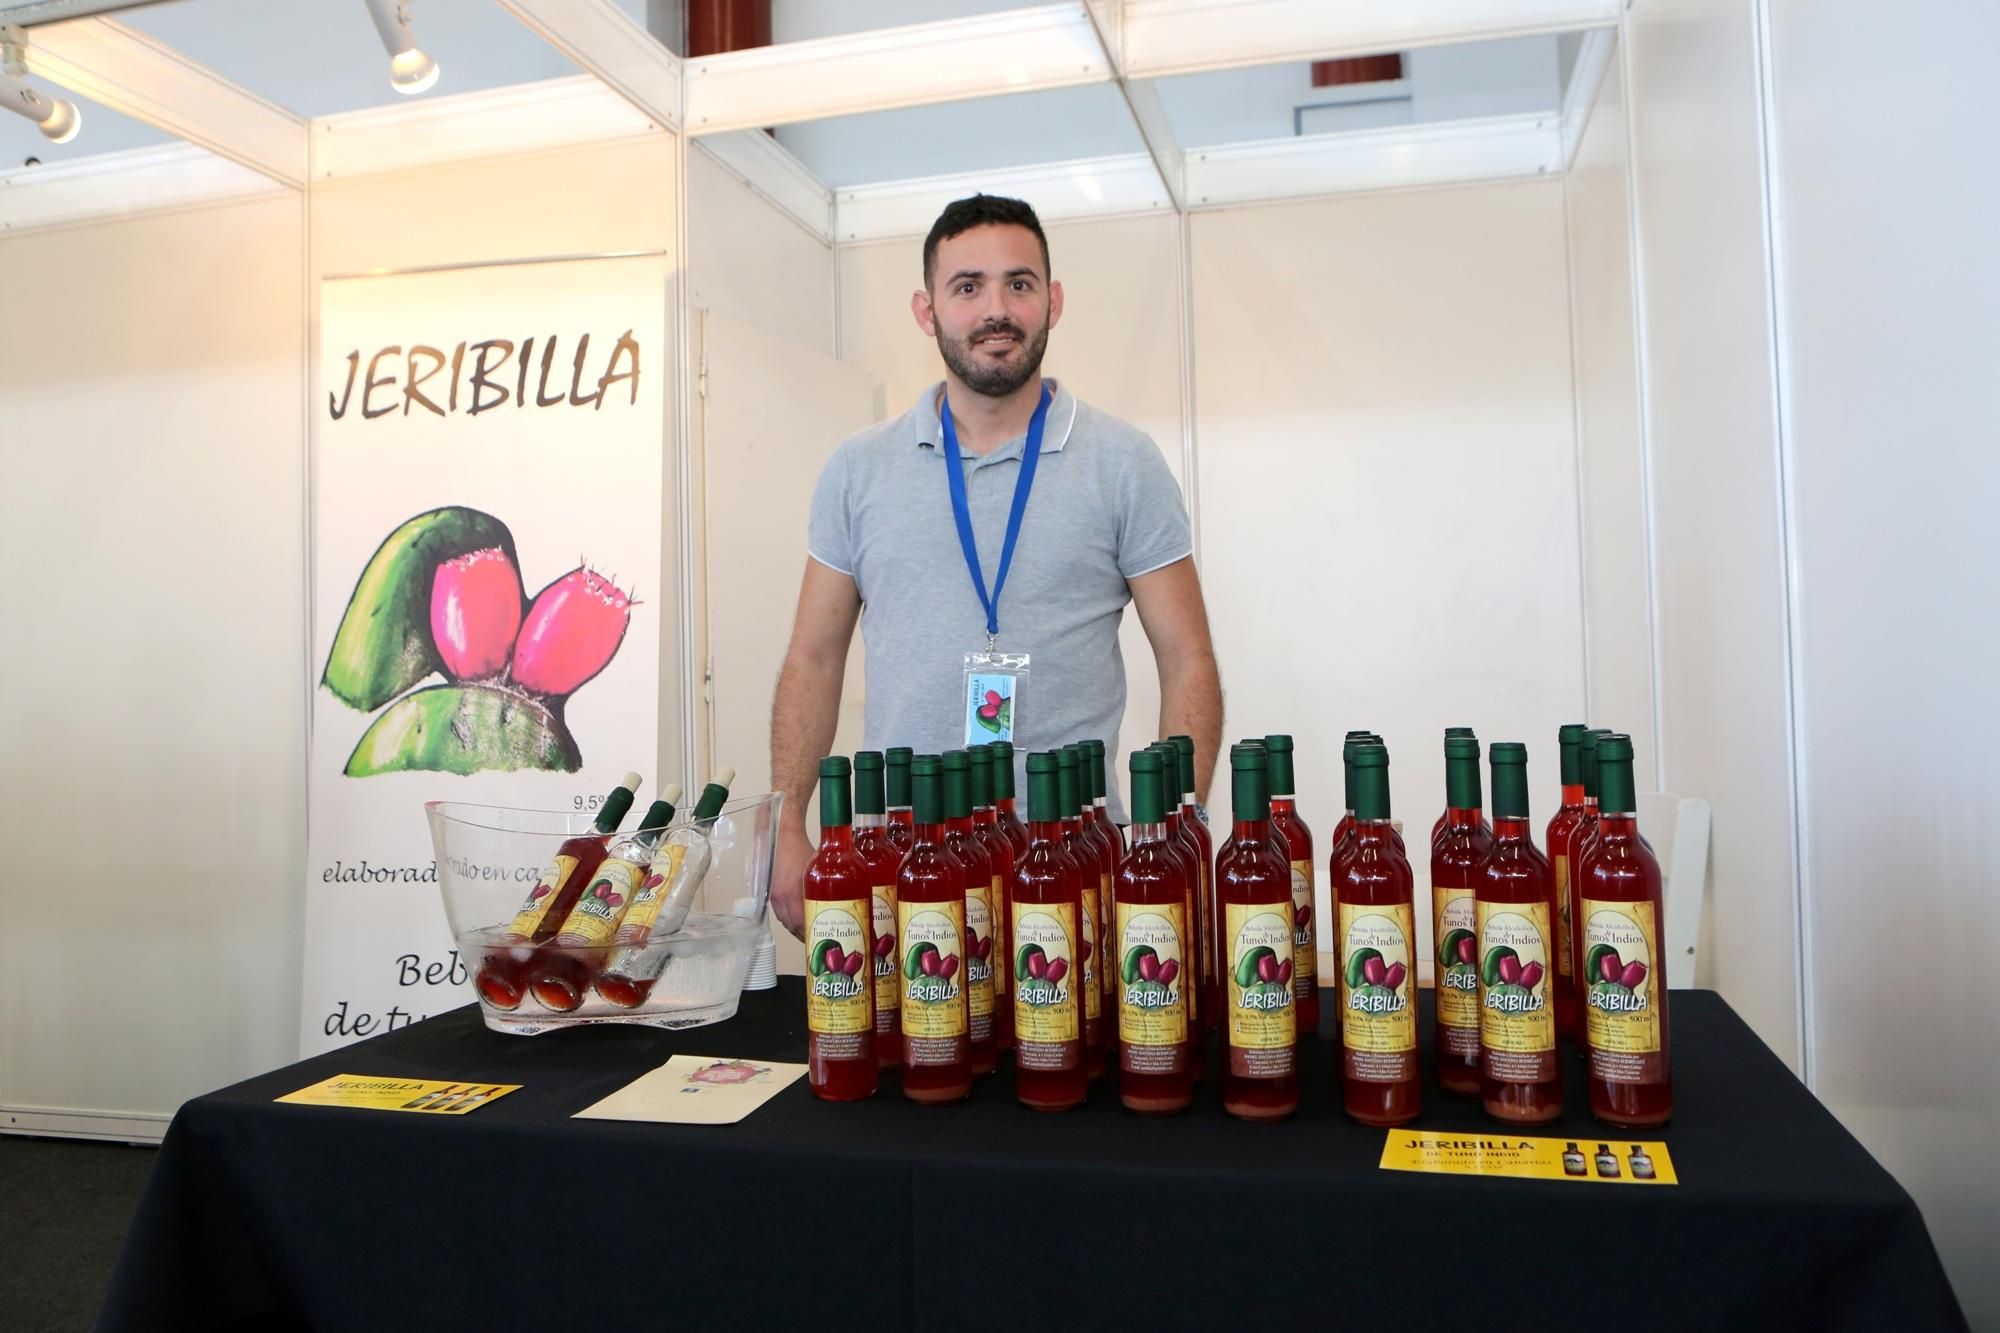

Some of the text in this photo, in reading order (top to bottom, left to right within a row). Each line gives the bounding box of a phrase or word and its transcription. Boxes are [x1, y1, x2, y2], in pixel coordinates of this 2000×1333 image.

[329, 328, 641, 420] JERIBILLA
[322, 860, 439, 884] elaborad
[1442, 915, 1467, 927] Tunos
[813, 927, 862, 938] Tunos Indios
[908, 929, 957, 940] Tunos Indios
[1017, 930, 1065, 943] Tunos Indios
[1125, 932, 1177, 944] Tunos Indios
[1240, 933, 1267, 945] Tunos
[1484, 932, 1541, 945] Tunos Indios
[1586, 930, 1644, 944] Tunos Indios
[1349, 934, 1404, 947] Tunos Indios
[1441, 972, 1478, 990] JERIB
[812, 981, 864, 997] JERIBILLA
[906, 985, 960, 1000] JERIBILLA
[1016, 988, 1068, 1004] JERIBILLA
[1123, 990, 1179, 1007] JERIBILLA
[1238, 991, 1293, 1009] JERIBILLA
[1347, 994, 1407, 1013] JERIBILLA
[1483, 993, 1544, 1012] JERIBILLA
[1587, 991, 1648, 1011] JERIBILLA
[324, 1001, 381, 1037] de
[328, 1082, 424, 1090] JERIBILLA
[1405, 1140, 1535, 1150] JERIBILLA
